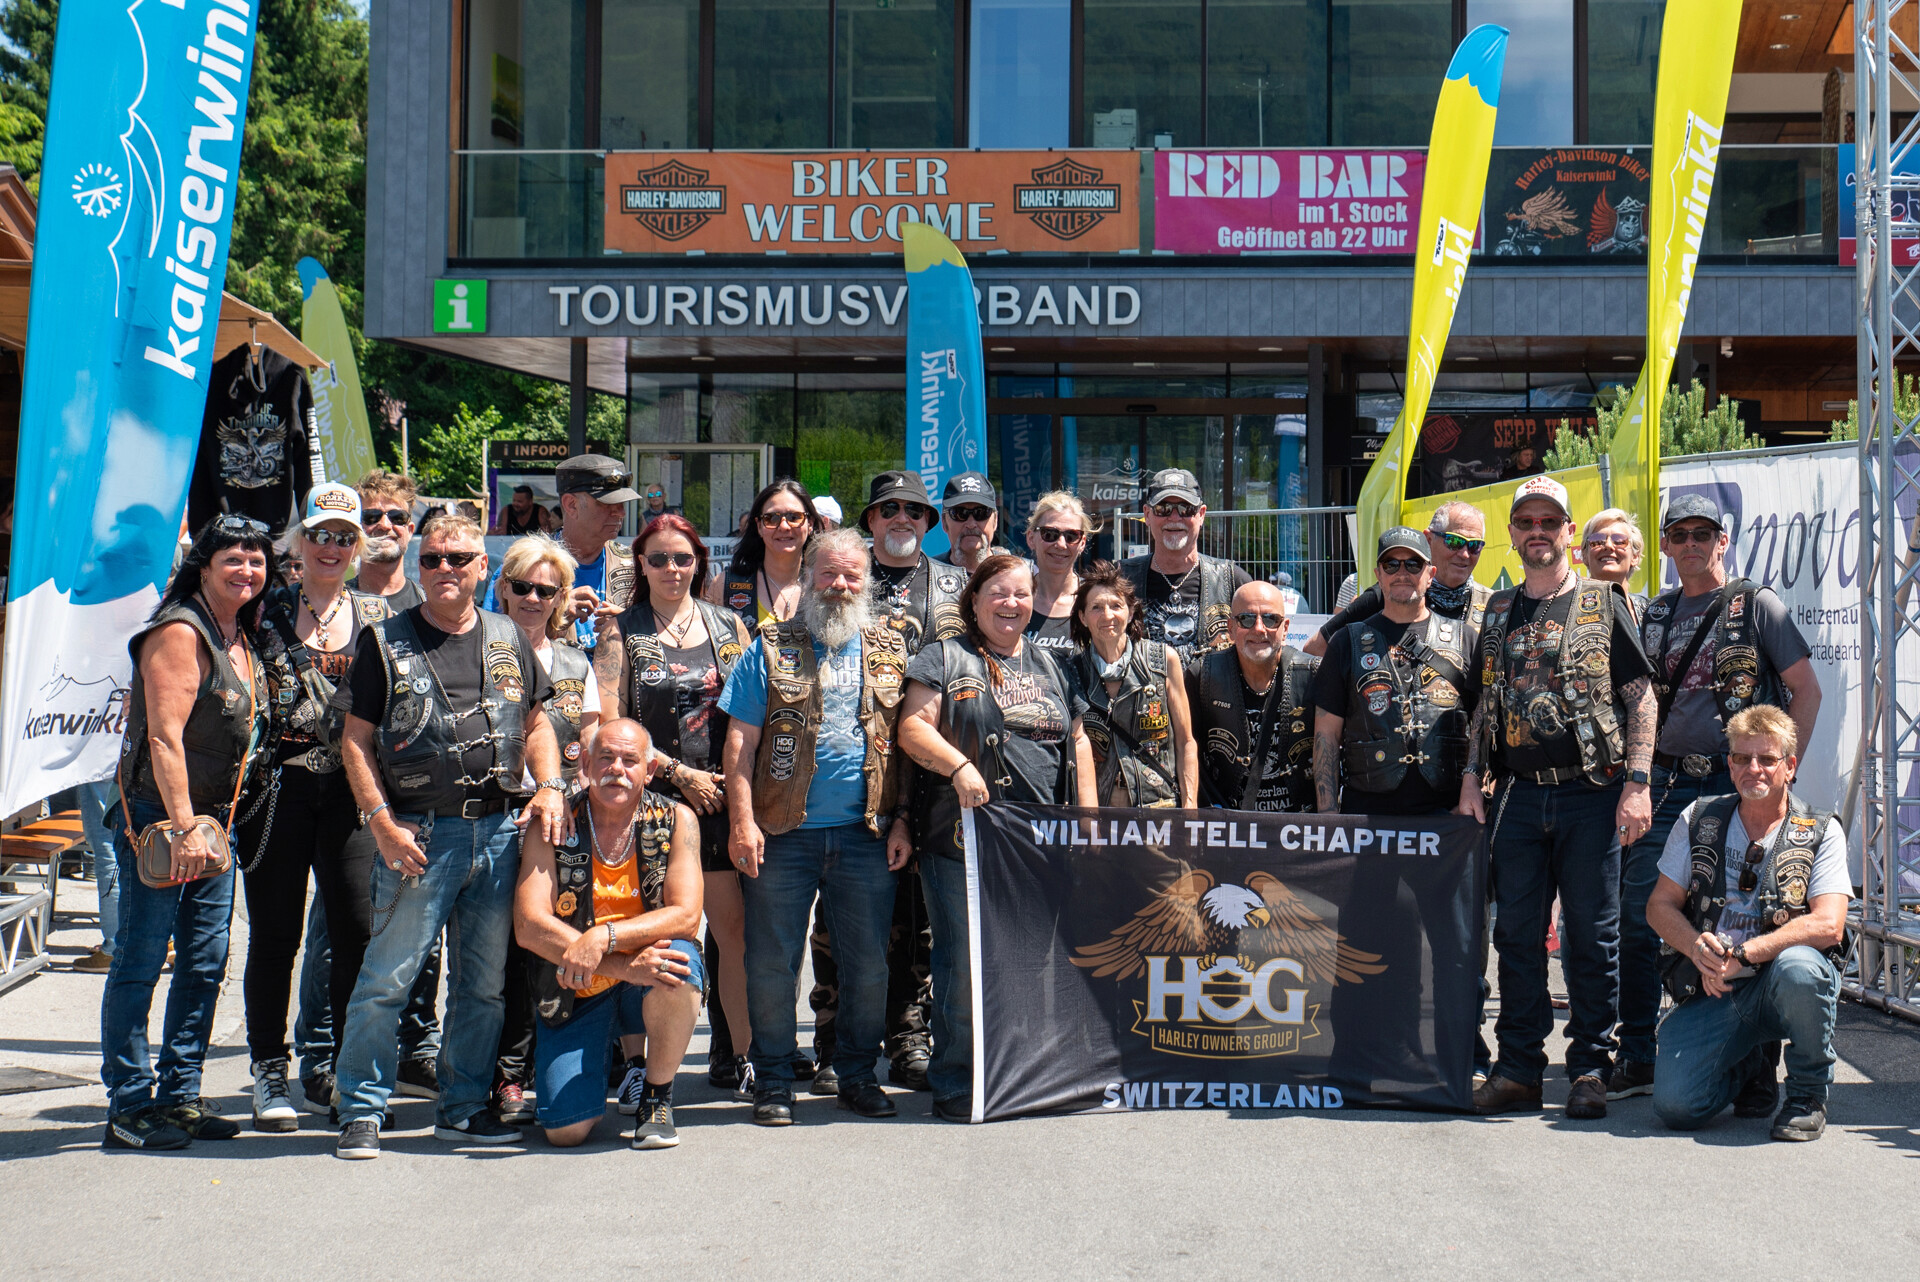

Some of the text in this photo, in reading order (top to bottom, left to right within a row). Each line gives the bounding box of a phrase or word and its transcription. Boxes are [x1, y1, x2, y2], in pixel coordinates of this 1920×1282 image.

[649, 170, 698, 186] MOTOR
[791, 157, 949, 198] BIKER
[1042, 166, 1092, 185] MOTOR
[1169, 153, 1409, 198] RED BAR
[1514, 149, 1651, 190] Harley-Davidson Biker
[1556, 170, 1616, 182] Kaiserwinkl
[627, 191, 720, 208] HARLEY-DAVIDSON
[1021, 190, 1114, 207] HARLEY-DAVIDSON
[742, 203, 997, 243] WELCOME
[1041, 212, 1091, 233] CYCLES
[1299, 202, 1408, 223] im 1. Stock
[648, 213, 698, 235] CYCLES
[1218, 226, 1408, 248] Geöffnet ab 22 Uhr
[549, 284, 1141, 327] TOURISMUSVBAND
[1493, 418, 1537, 449] SEPP
[515, 444, 592, 456] INFOPOT
[1545, 619, 1564, 634] CIT
[1811, 639, 1861, 665] ntagearb
[1030, 818, 1441, 856] WILLIAM TELL CHAPTER
[559, 853, 583, 863] MORITZ
[1143, 953, 1309, 1025] HOG
[1158, 1027, 1293, 1051] HARLEY OWNERS GROUP
[1102, 1081, 1344, 1109] SWITZERLAND
